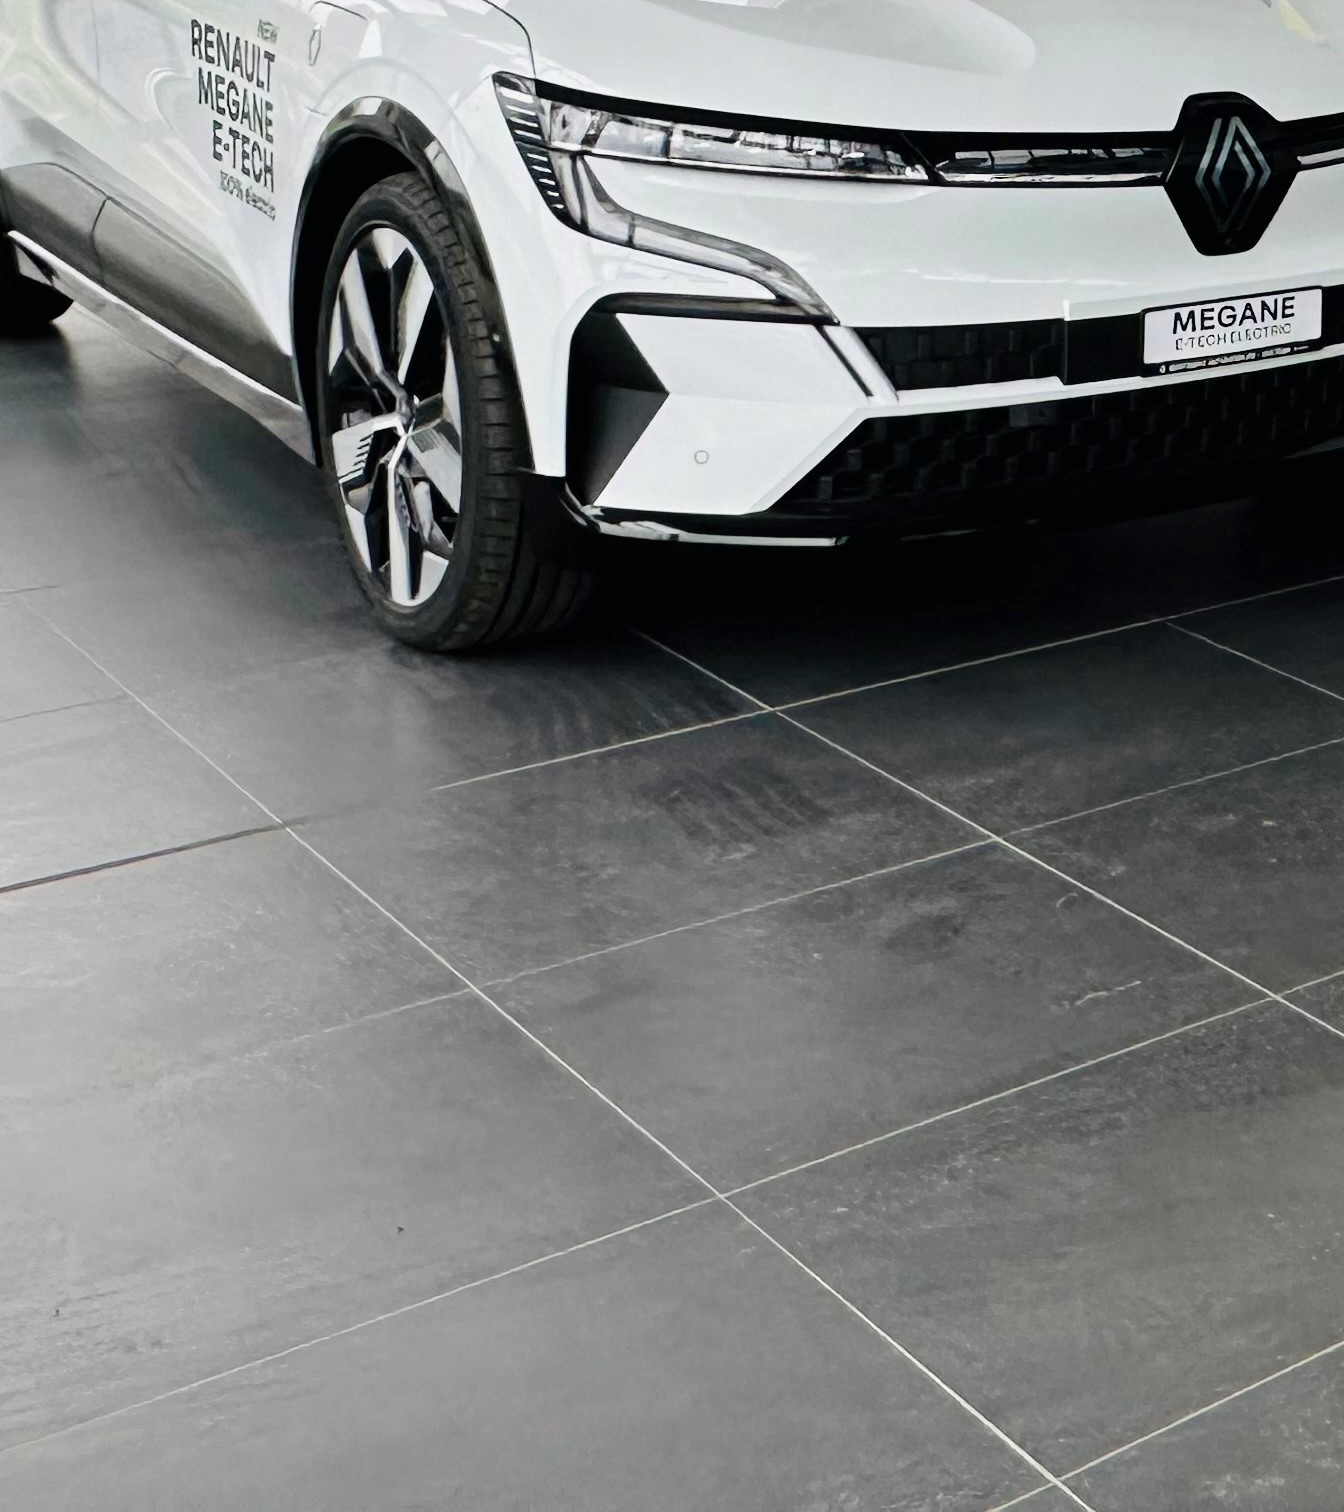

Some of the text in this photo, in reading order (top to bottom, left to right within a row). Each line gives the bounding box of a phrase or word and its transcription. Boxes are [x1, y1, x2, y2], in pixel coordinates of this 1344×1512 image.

[190, 18, 276, 93] RENAULT
[198, 66, 274, 145] MEGANE
[212, 119, 275, 193] E-TECH
[1172, 295, 1296, 335] MEGANE
